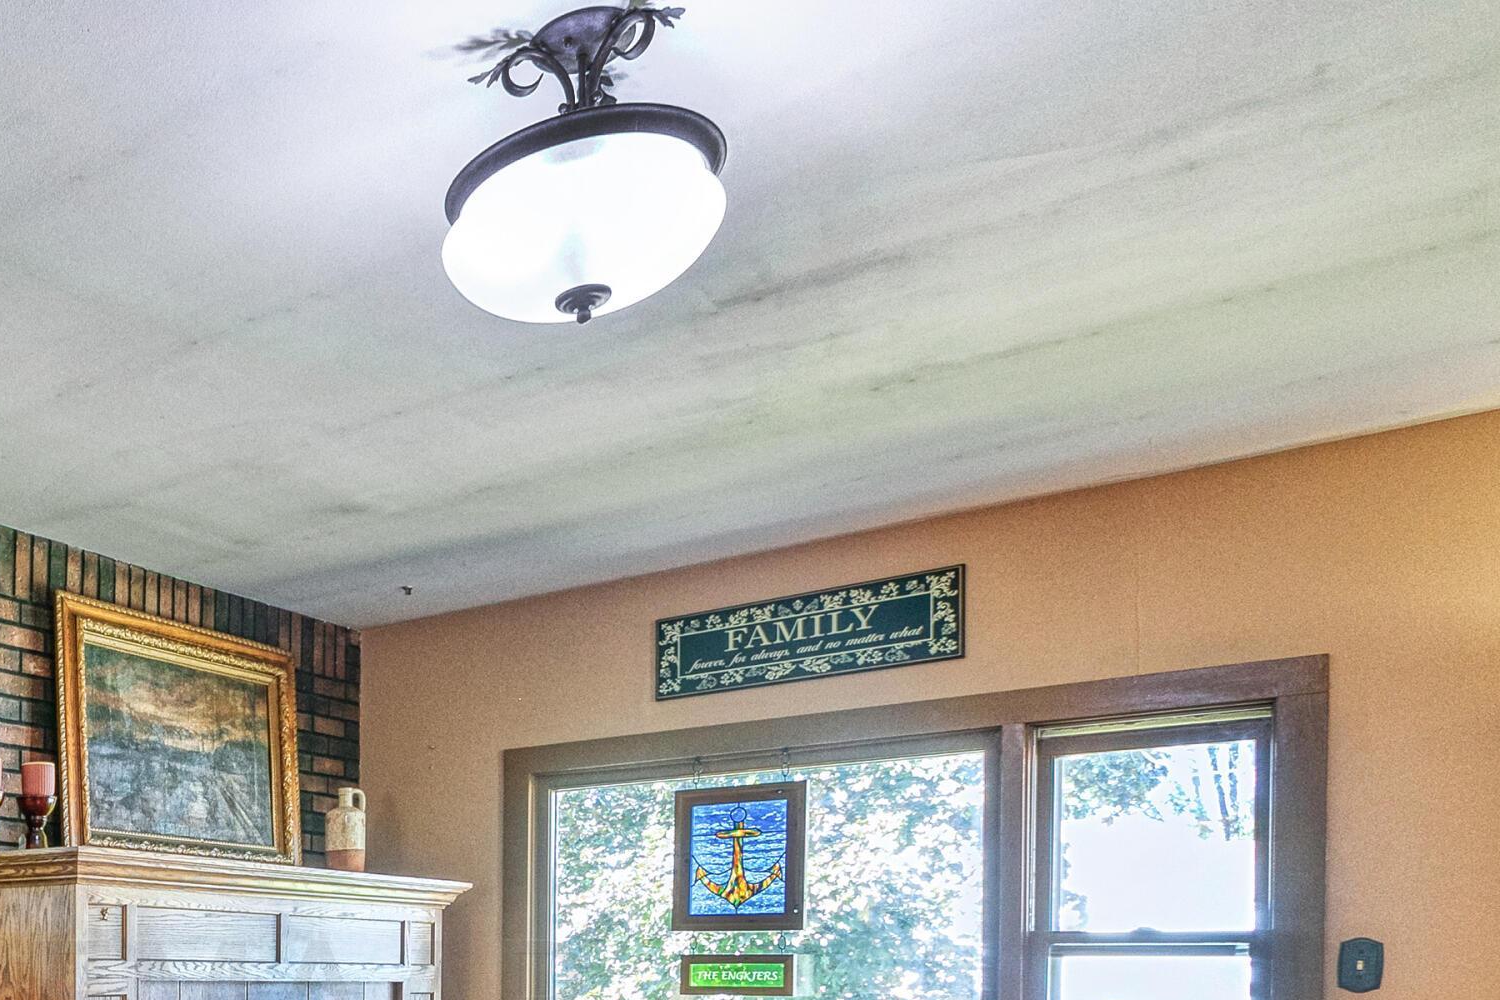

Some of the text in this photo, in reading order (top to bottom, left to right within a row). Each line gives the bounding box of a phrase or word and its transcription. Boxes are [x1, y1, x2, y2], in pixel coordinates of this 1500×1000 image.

[724, 604, 881, 653] FAMILY
[796, 640, 822, 654] and
[825, 640, 841, 649] no
[844, 632, 885, 648] matter
[889, 625, 924, 641] what
[697, 971, 778, 982] THE ENGKJERS
